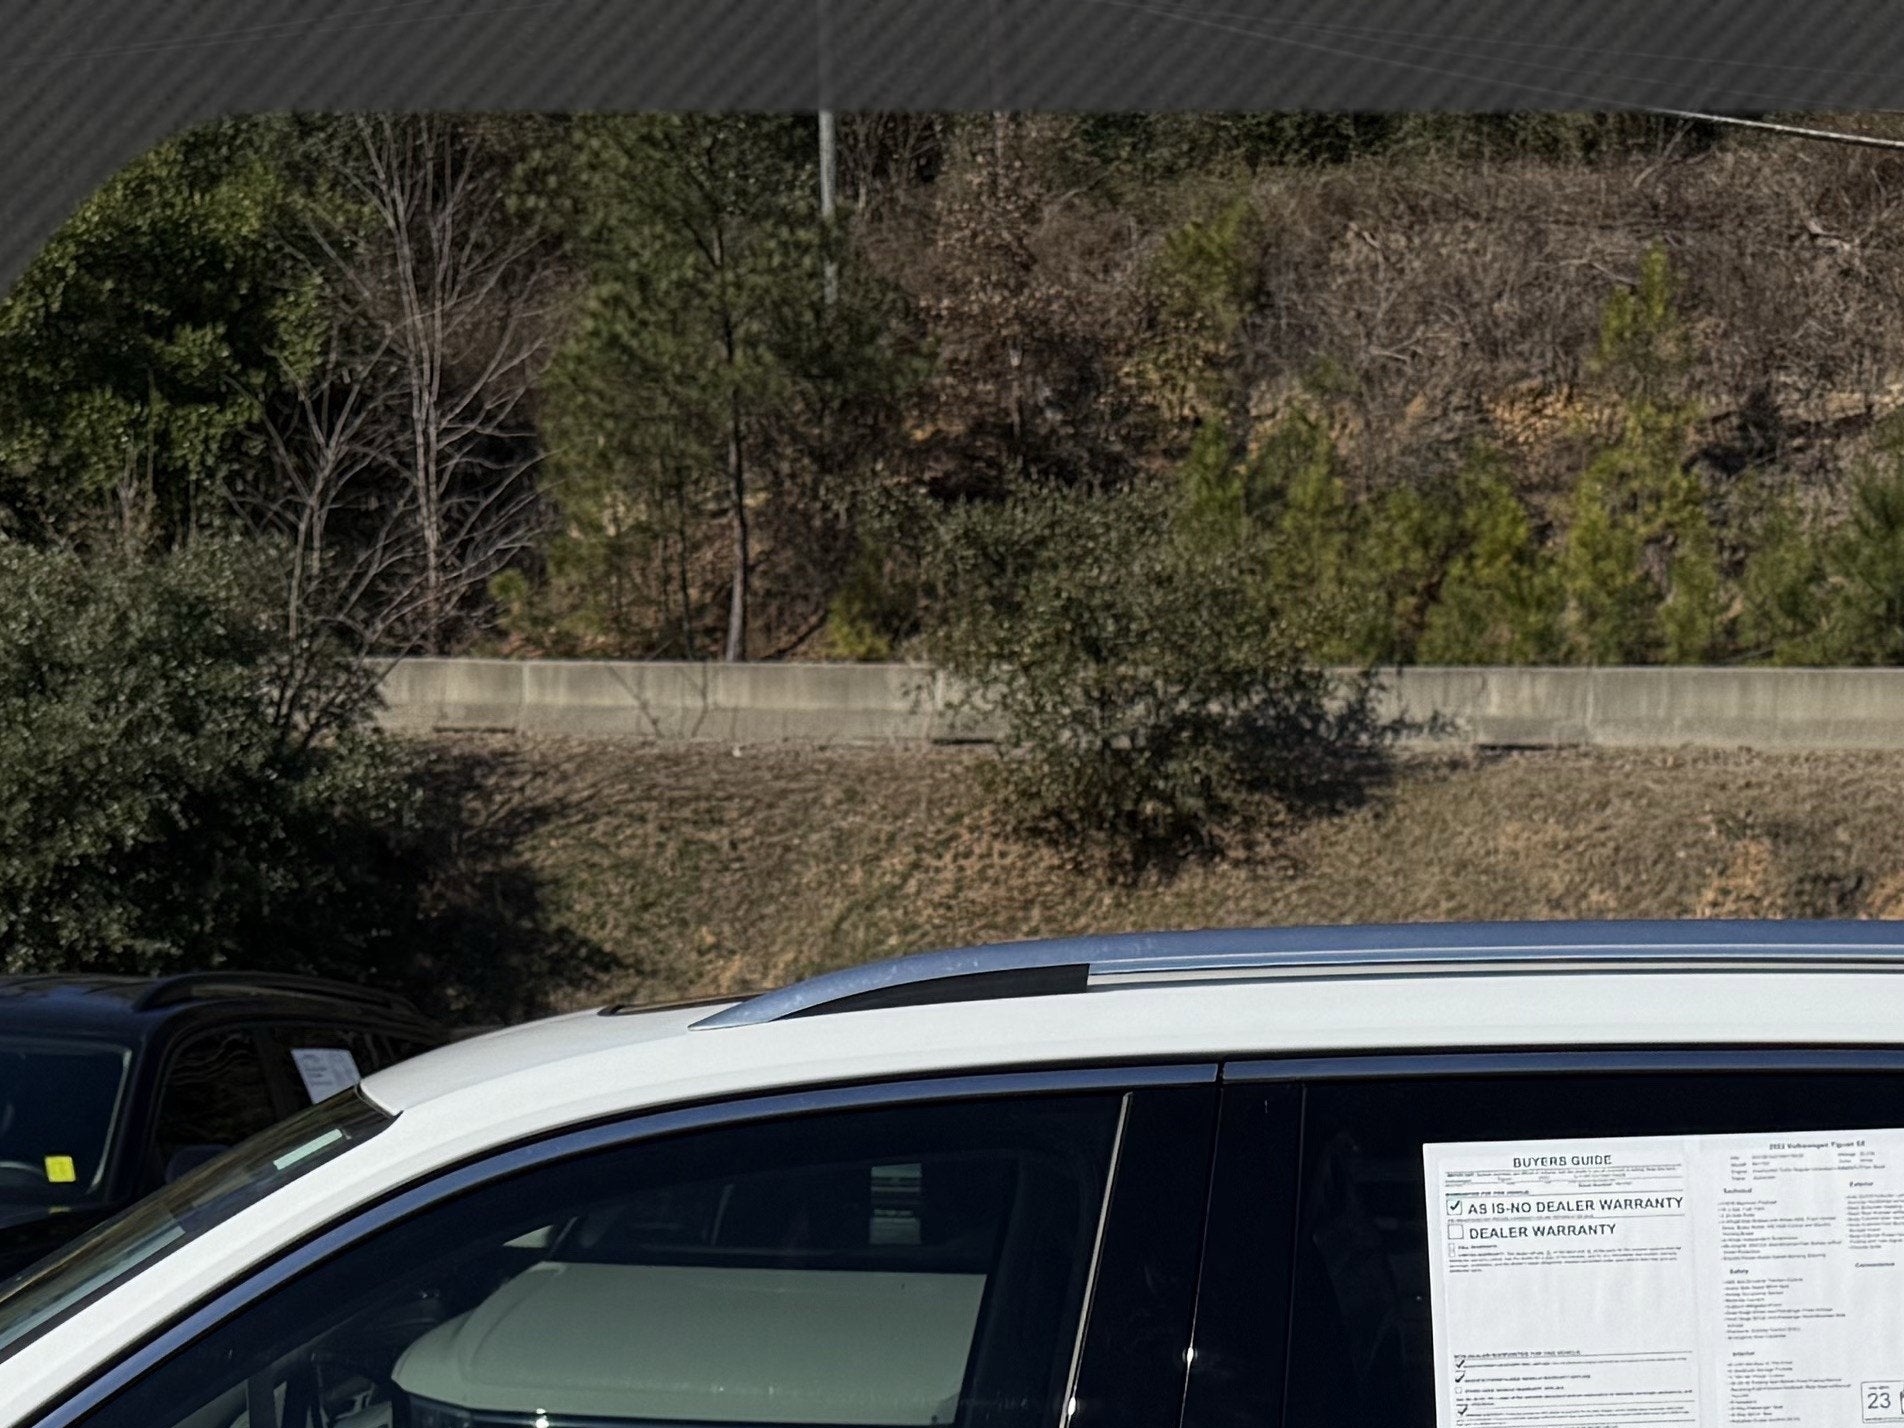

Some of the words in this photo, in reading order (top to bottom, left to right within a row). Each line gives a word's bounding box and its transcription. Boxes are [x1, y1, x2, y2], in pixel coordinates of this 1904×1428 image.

[1512, 1156, 1567, 1168] BUYERS
[1571, 1154, 1612, 1166] GUIDE
[1467, 1202, 1488, 1215] AS
[1491, 1200, 1532, 1214] IS-NO
[1536, 1198, 1595, 1213] DEALER
[1599, 1196, 1684, 1211] WARRANTY
[1469, 1226, 1529, 1240] DEALER
[1532, 1223, 1616, 1238] WARRANTY
[1866, 1392, 1892, 1409] 23
